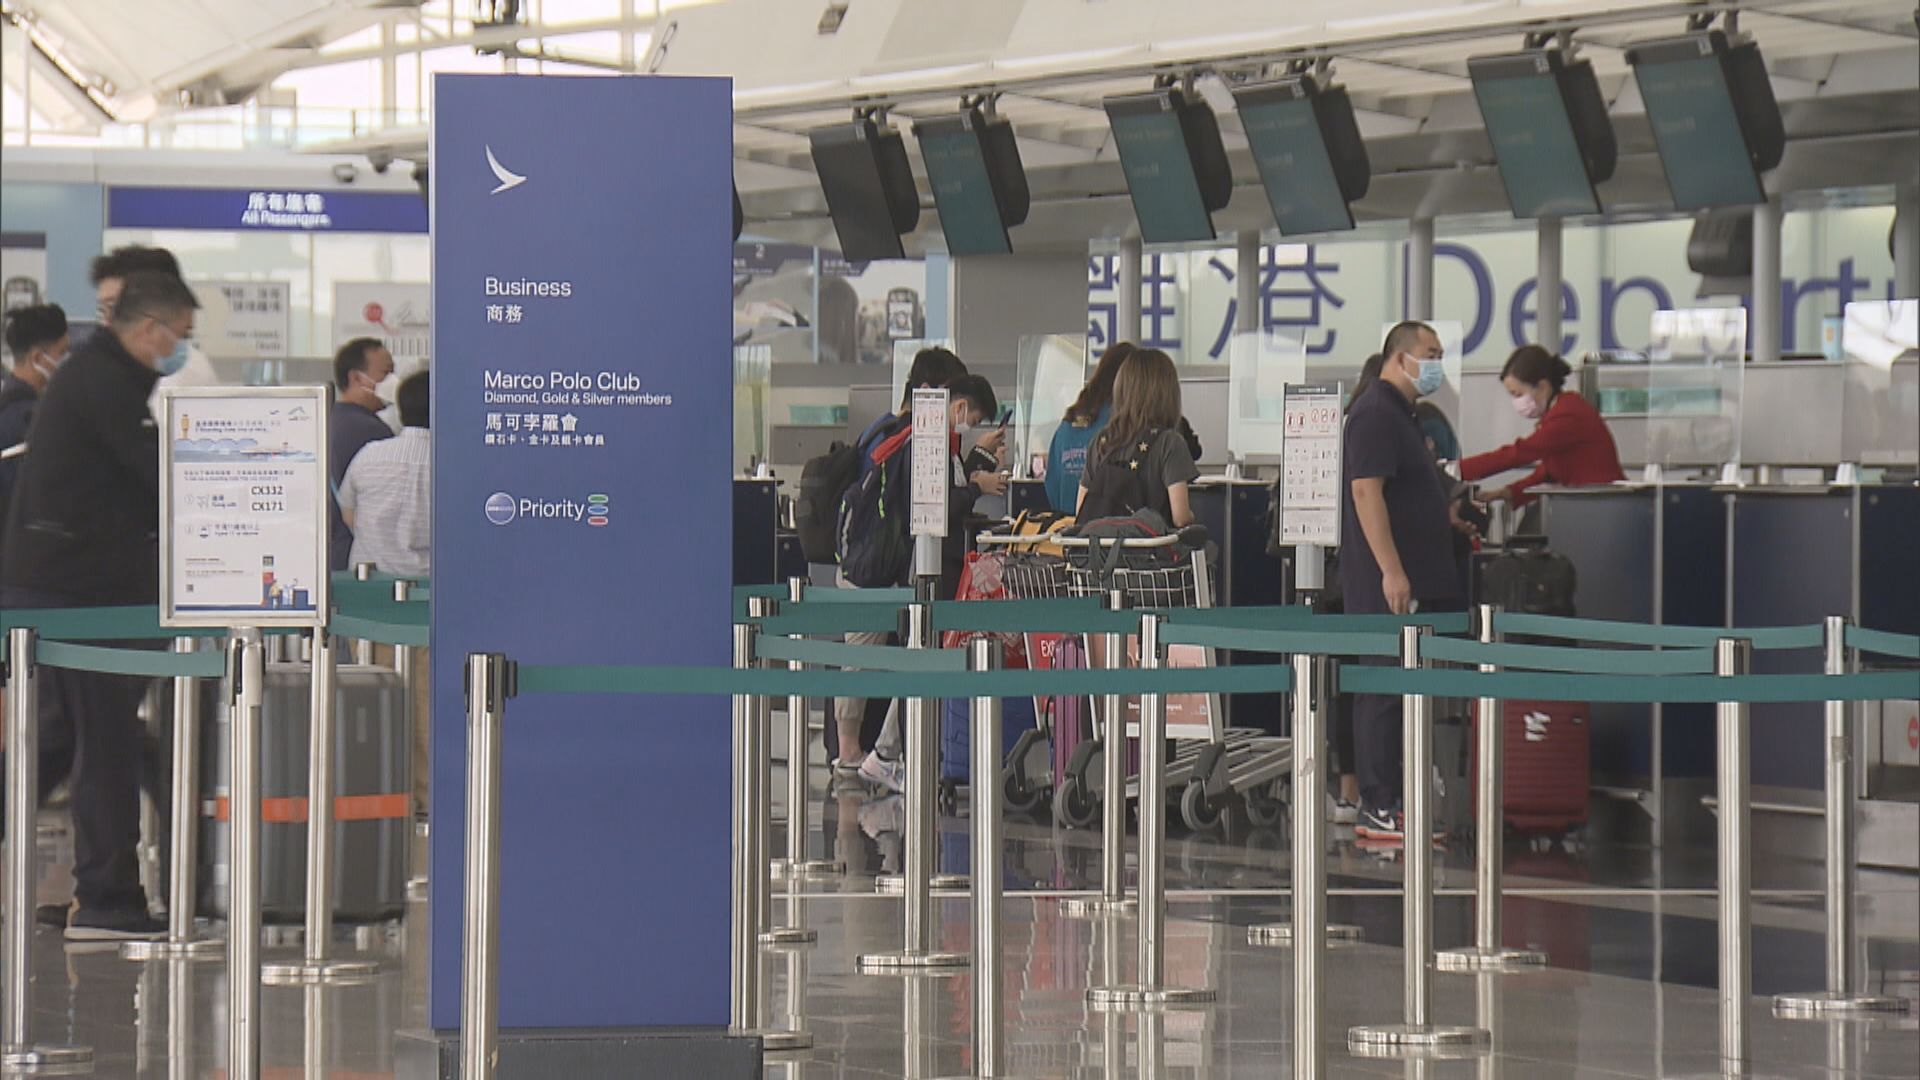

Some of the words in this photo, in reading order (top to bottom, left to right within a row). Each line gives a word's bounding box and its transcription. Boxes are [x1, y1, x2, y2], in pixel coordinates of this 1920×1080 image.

[248, 192, 324, 213] 所有旅客
[241, 210, 259, 225] All
[261, 210, 332, 228] Passengers
[755, 243, 766, 259] 2
[485, 277, 572, 296] Business
[486, 304, 523, 323] 商務
[484, 370, 545, 390] Marco
[550, 371, 592, 391] Polo
[597, 371, 641, 392] Club
[484, 391, 539, 404] Diamond,
[541, 392, 569, 404] Gold
[571, 392, 580, 405] &
[582, 392, 614, 405] Silver
[617, 393, 672, 406] members
[251, 485, 284, 495] CX332
[251, 501, 285, 511] CX171
[519, 498, 585, 521] Priority
